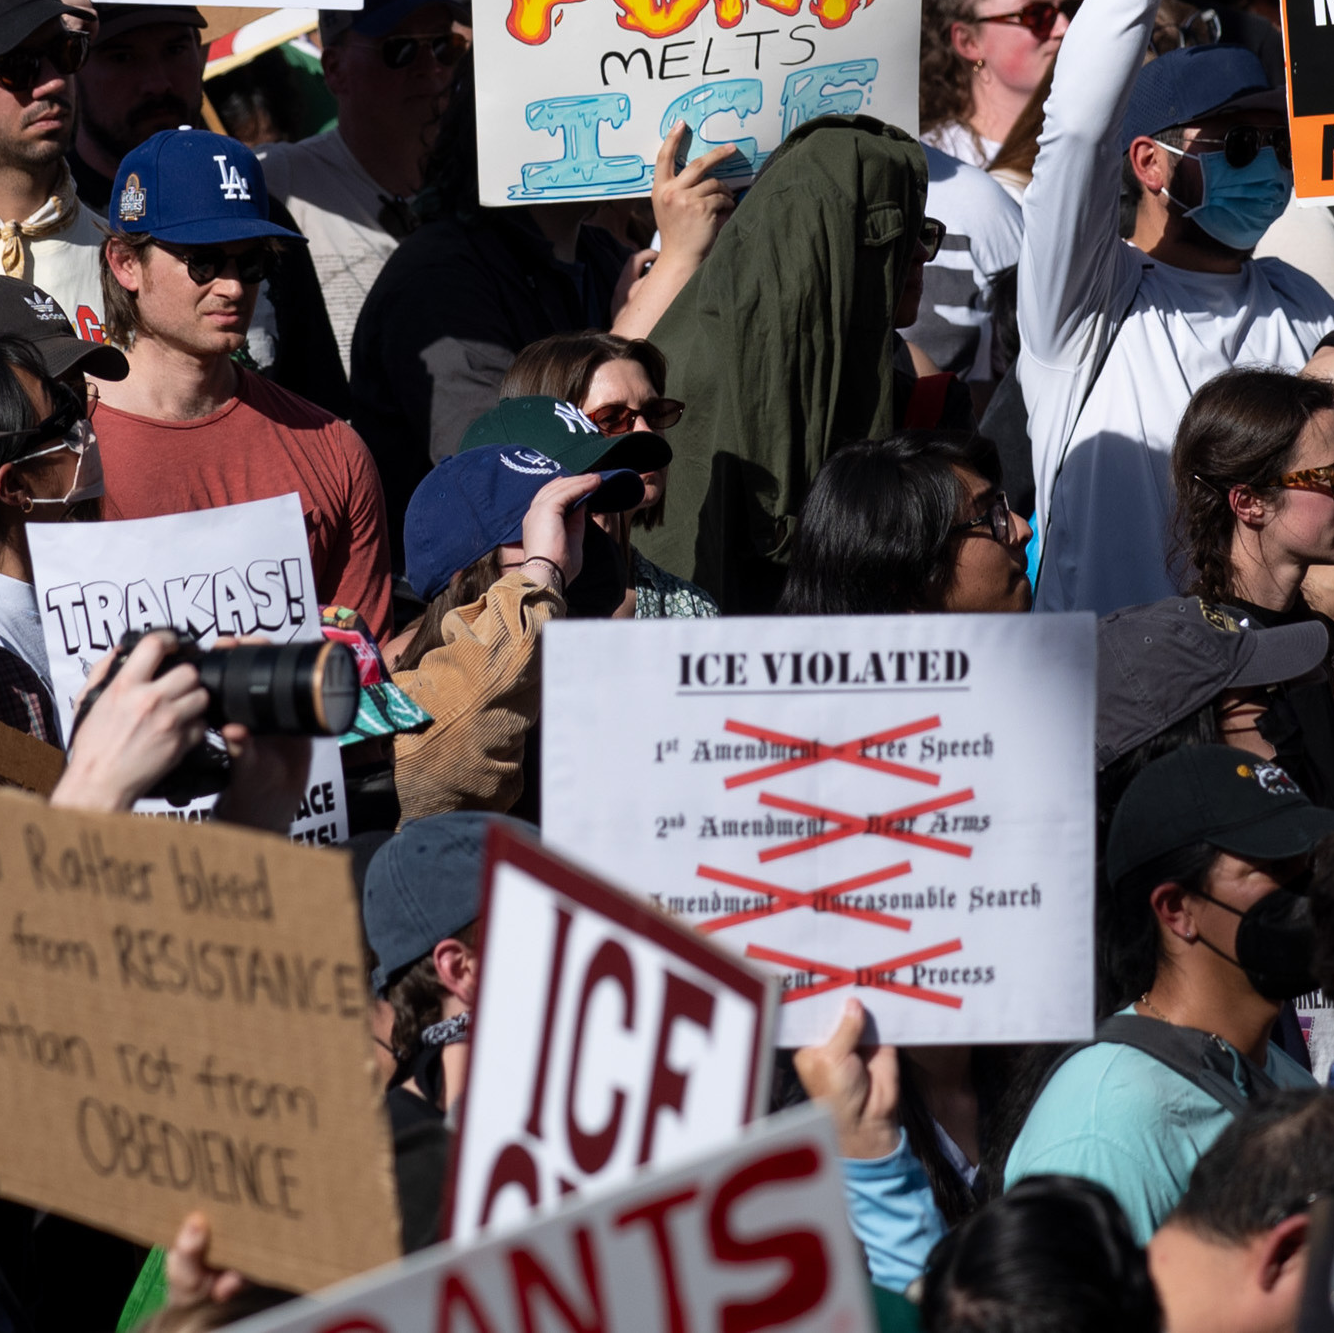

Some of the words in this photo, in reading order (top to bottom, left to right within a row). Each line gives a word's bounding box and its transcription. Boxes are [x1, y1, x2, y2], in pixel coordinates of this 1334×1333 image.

[600, 24, 817, 86] MELTS
[519, 57, 880, 193] ICE
[213, 154, 251, 200] LA
[552, 400, 600, 435] NY
[46, 557, 305, 655] TRAKAS!
[678, 653, 749, 686] ICE
[761, 648, 972, 685] VIOLATED
[653, 738, 680, 763] 1st
[691, 737, 820, 765] Amendment
[857, 735, 908, 760] Free
[919, 732, 996, 764] Speech
[293, 780, 336, 822] ACE
[655, 813, 686, 840] 2nd
[699, 814, 828, 840] Amendment
[928, 811, 991, 835] Arms
[25, 824, 155, 906] Rather
[170, 844, 276, 922] bleed
[812, 886, 957, 914] Unreasonable
[968, 882, 1042, 911] Search
[11, 911, 98, 985] from
[112, 923, 365, 1019] RESISTANCE
[854, 965, 903, 990] Due
[910, 963, 996, 989] Process
[524, 897, 719, 1179] ICE
[116, 1041, 181, 1096] rot
[197, 1053, 320, 1131] from
[76, 1094, 304, 1221] OBEDIENCE
[312, 1140, 831, 1333] NTS
